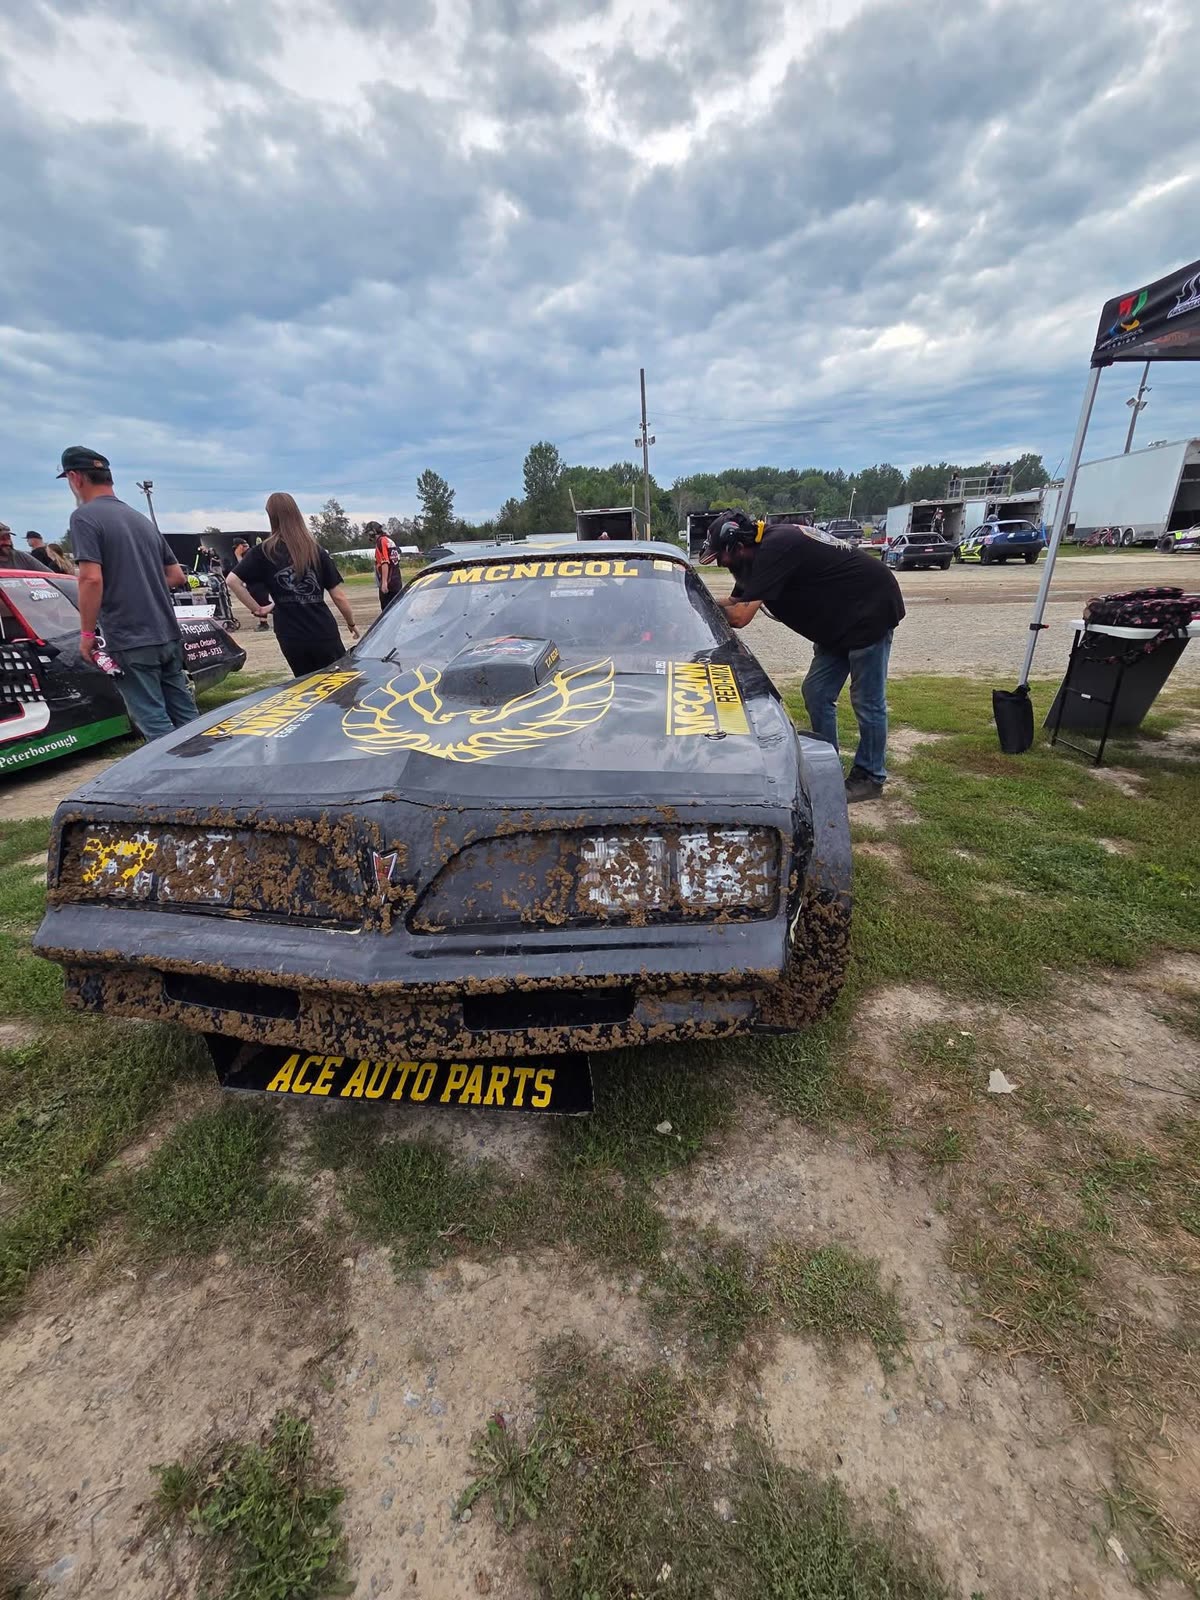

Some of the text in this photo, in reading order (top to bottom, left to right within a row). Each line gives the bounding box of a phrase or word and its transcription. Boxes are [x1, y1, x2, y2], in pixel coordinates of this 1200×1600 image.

[448, 560, 638, 585] MCNICOL
[181, 621, 210, 635] Repair
[200, 638, 217, 648] Ontario
[0, 735, 78, 768] Peterborough
[266, 1054, 555, 1108] ACE AUTO PARTS
